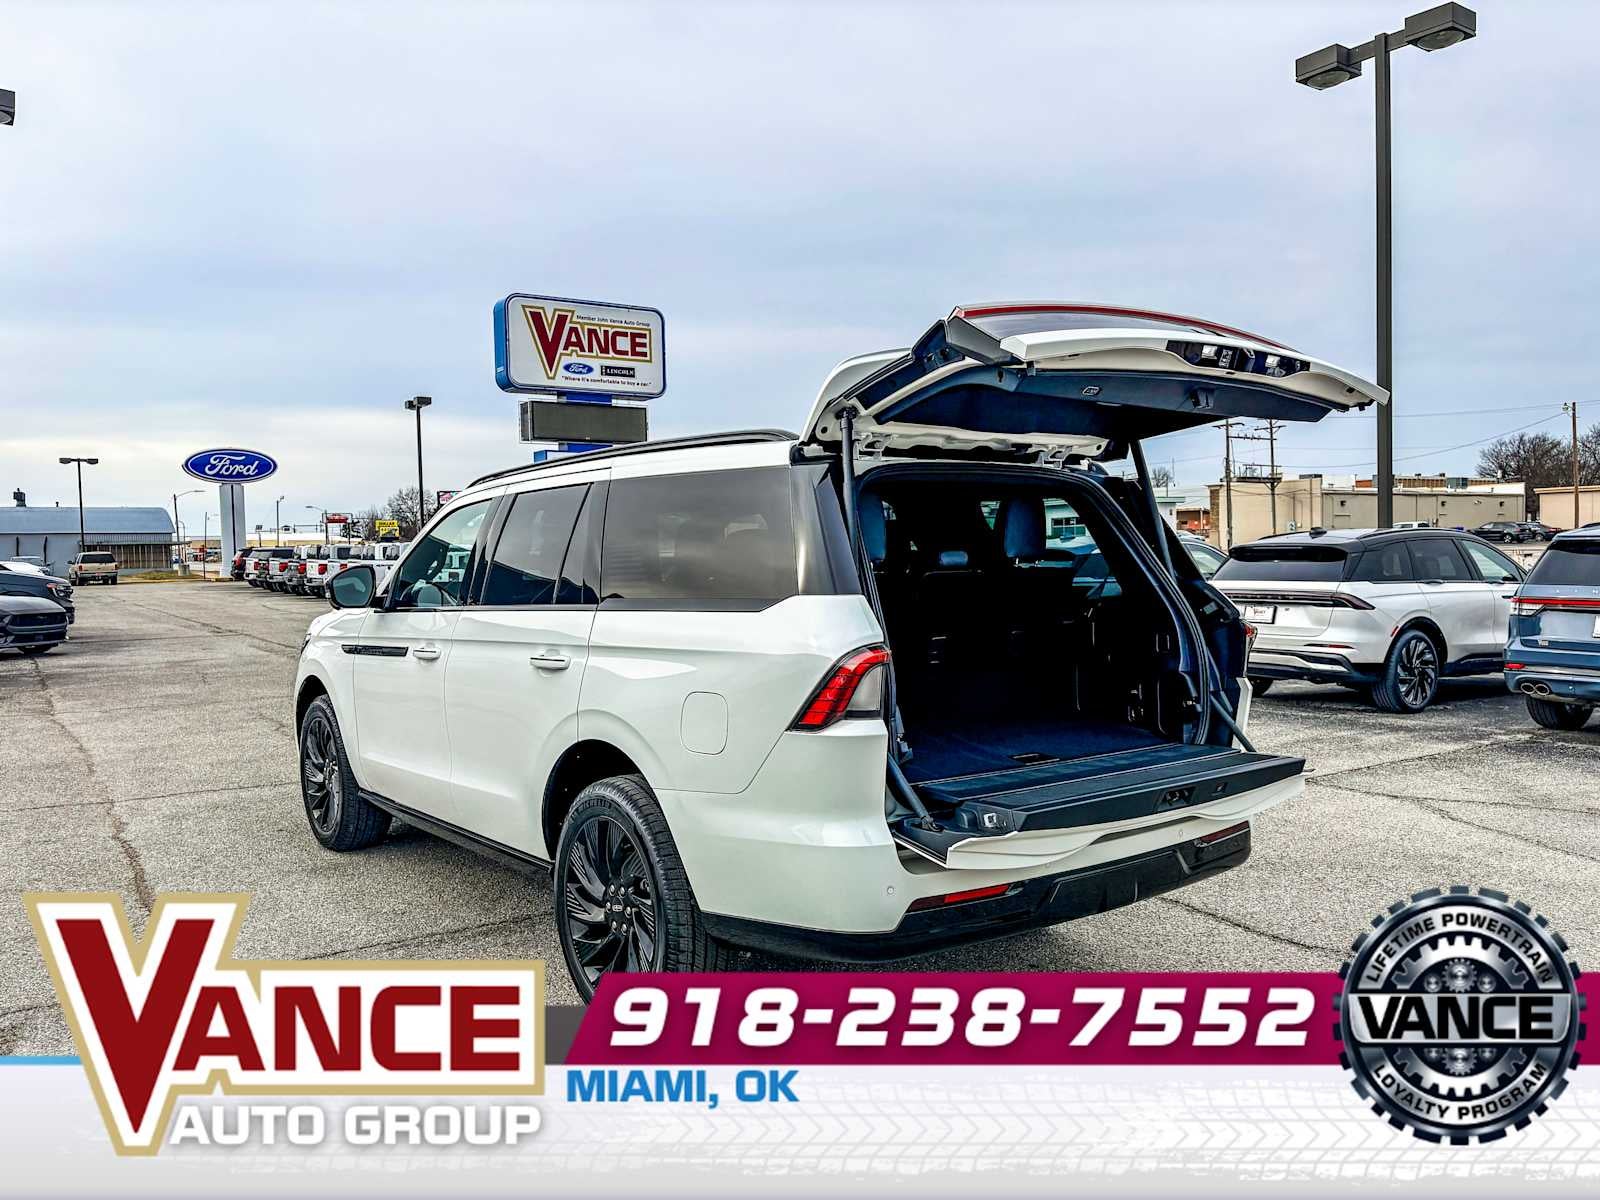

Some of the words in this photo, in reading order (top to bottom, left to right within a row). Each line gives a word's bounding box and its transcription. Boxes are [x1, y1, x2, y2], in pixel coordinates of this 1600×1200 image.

[528, 310, 648, 373] VANCE
[606, 367, 635, 377] LINCOLN
[204, 454, 260, 475] Ford
